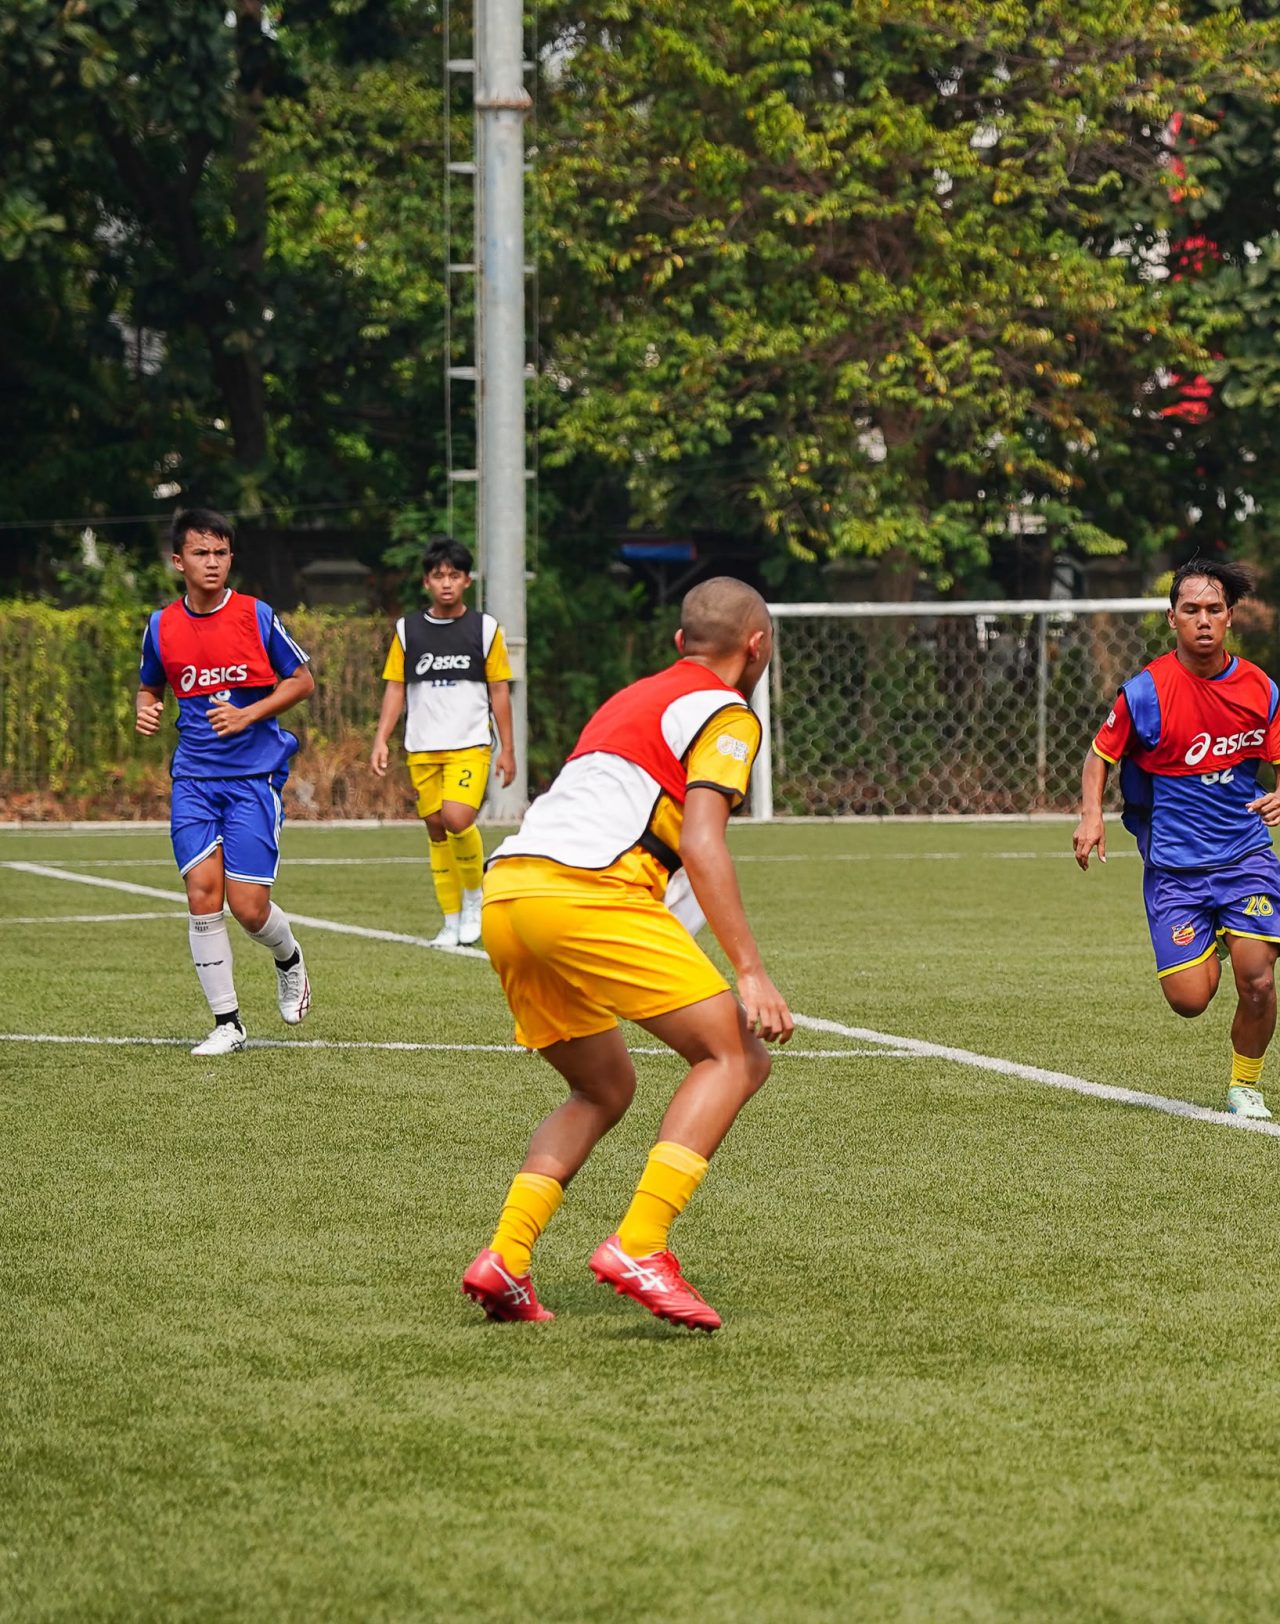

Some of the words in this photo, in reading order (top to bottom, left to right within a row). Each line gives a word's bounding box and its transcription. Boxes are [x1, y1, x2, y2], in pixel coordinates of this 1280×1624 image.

[432, 654, 471, 671] asics
[198, 664, 248, 686] asics
[1212, 728, 1266, 756] asics
[458, 769, 472, 788] 2
[1242, 895, 1274, 917] 26
